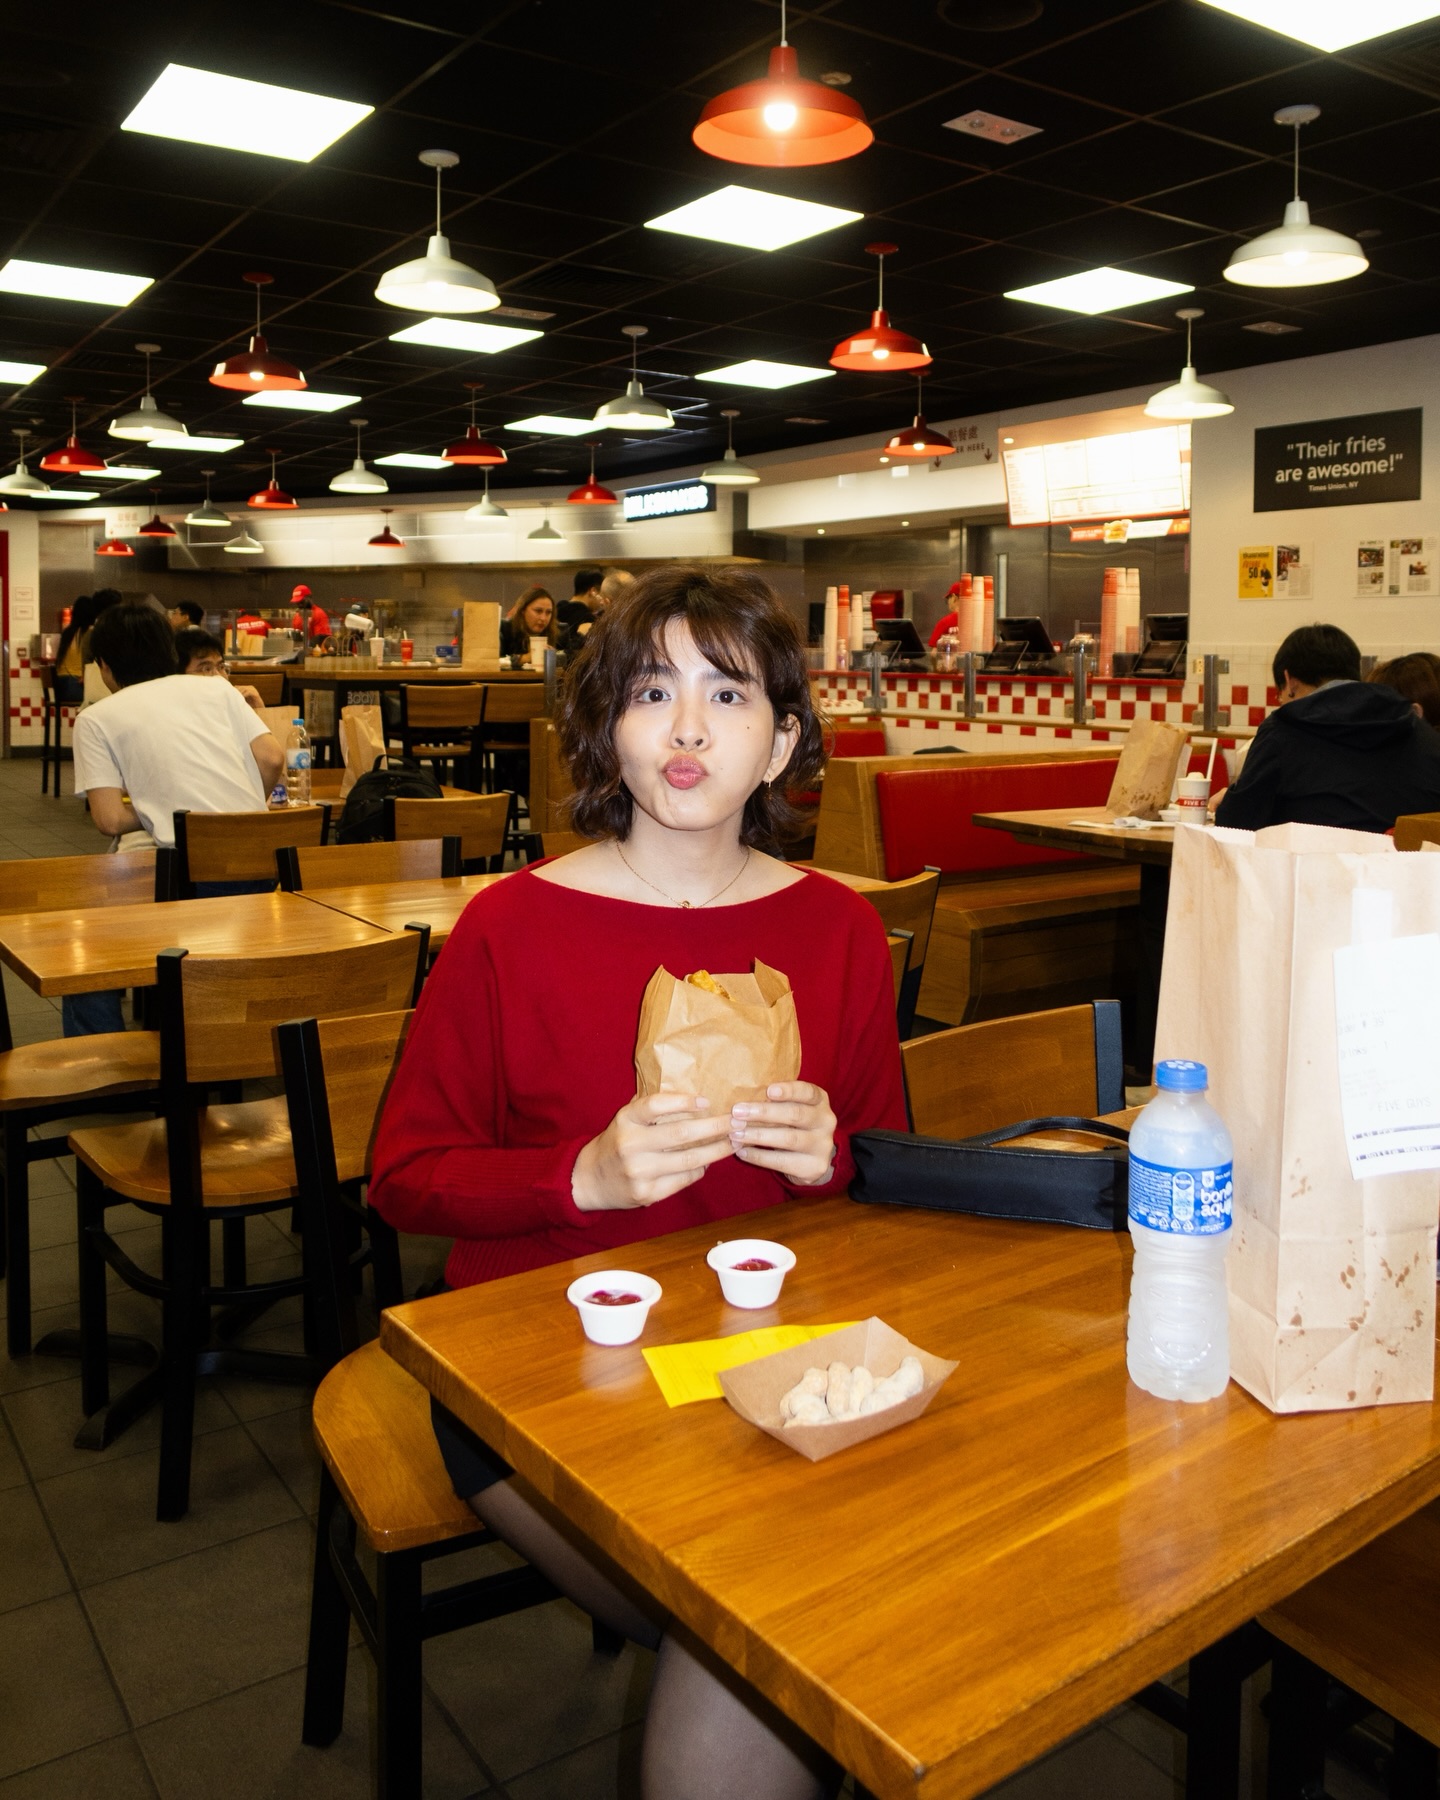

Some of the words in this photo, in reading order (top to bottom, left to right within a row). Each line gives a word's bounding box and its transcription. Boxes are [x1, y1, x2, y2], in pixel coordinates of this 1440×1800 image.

[1287, 439, 1341, 460] "Their
[1346, 435, 1386, 454] fries
[1275, 467, 1303, 483] are
[1307, 453, 1403, 480] awesome!"
[1308, 484, 1327, 492] Times
[1248, 567, 1259, 578] 50
